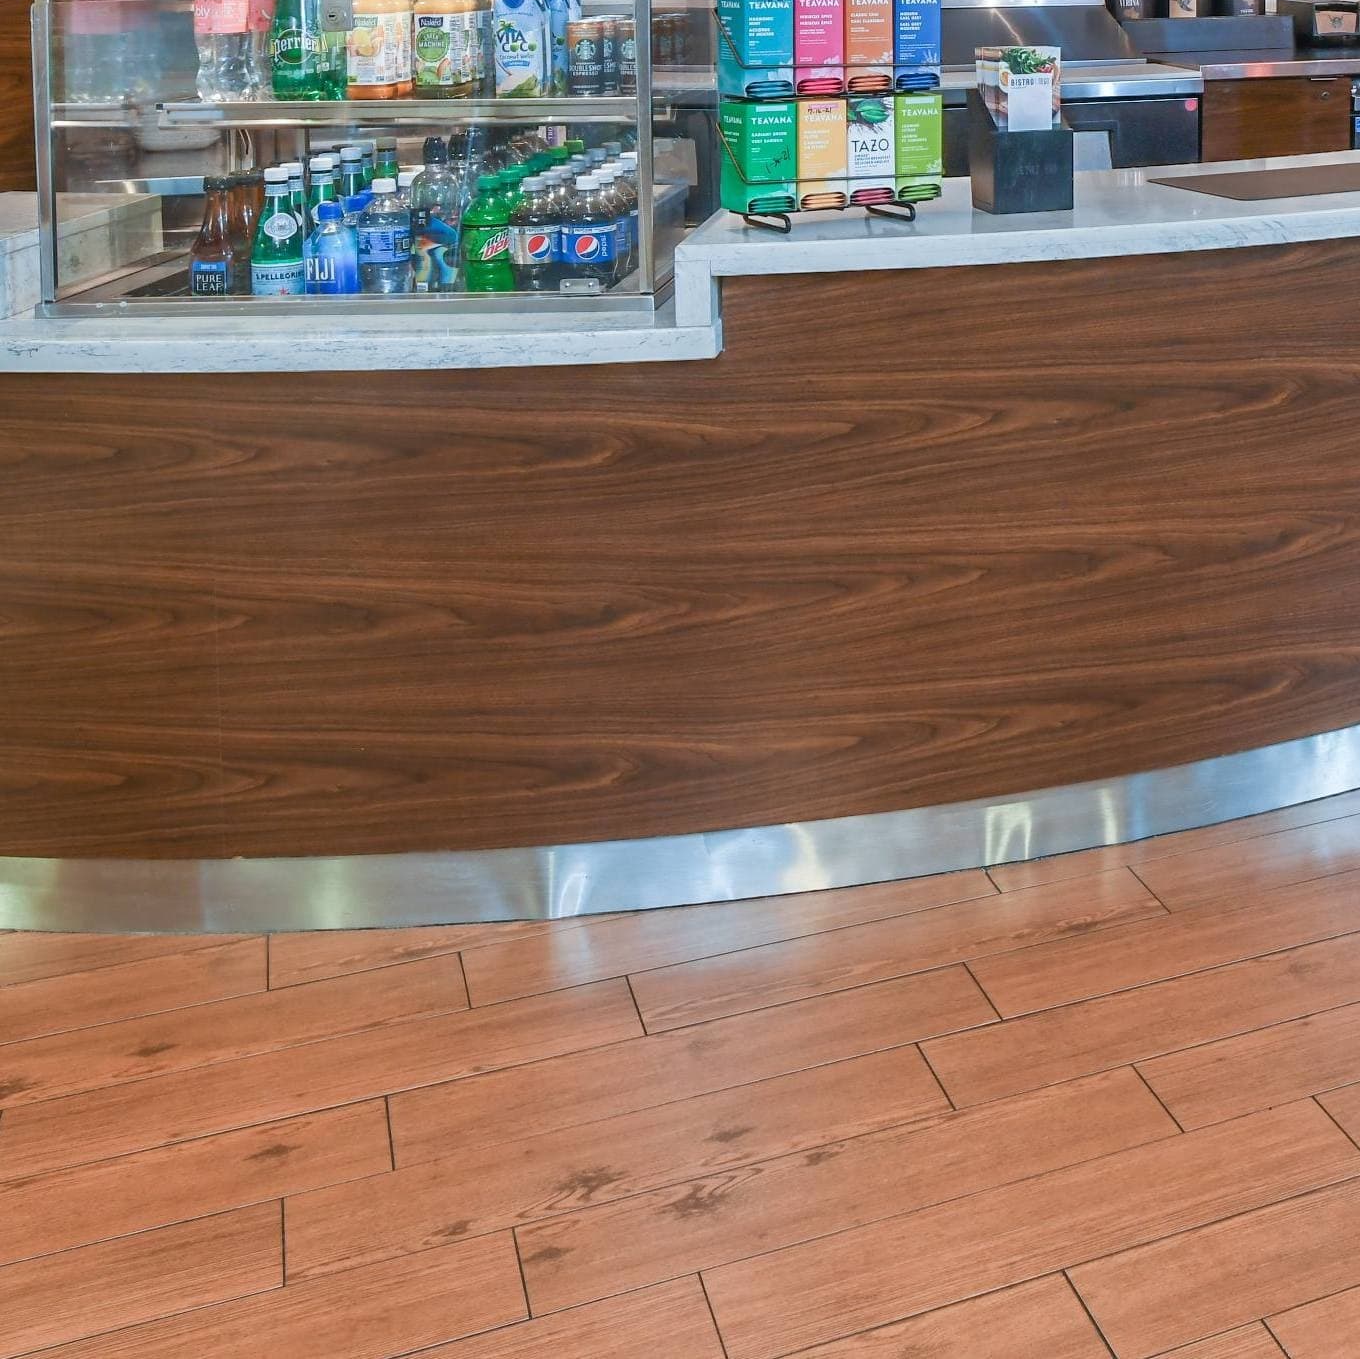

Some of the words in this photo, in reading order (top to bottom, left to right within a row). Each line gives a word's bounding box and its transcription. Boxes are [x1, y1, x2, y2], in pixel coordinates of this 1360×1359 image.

[749, 1, 790, 10] TEAVANA
[799, 0, 840, 7] TEAVANA
[1010, 78, 1035, 87] BISTRO
[902, 109, 939, 117] TEAVANA
[751, 116, 793, 125] TEAVANA
[851, 138, 890, 153] TAZO
[306, 257, 336, 281] FIJI
[196, 274, 223, 283] PURE
[196, 283, 223, 291] LEAF
